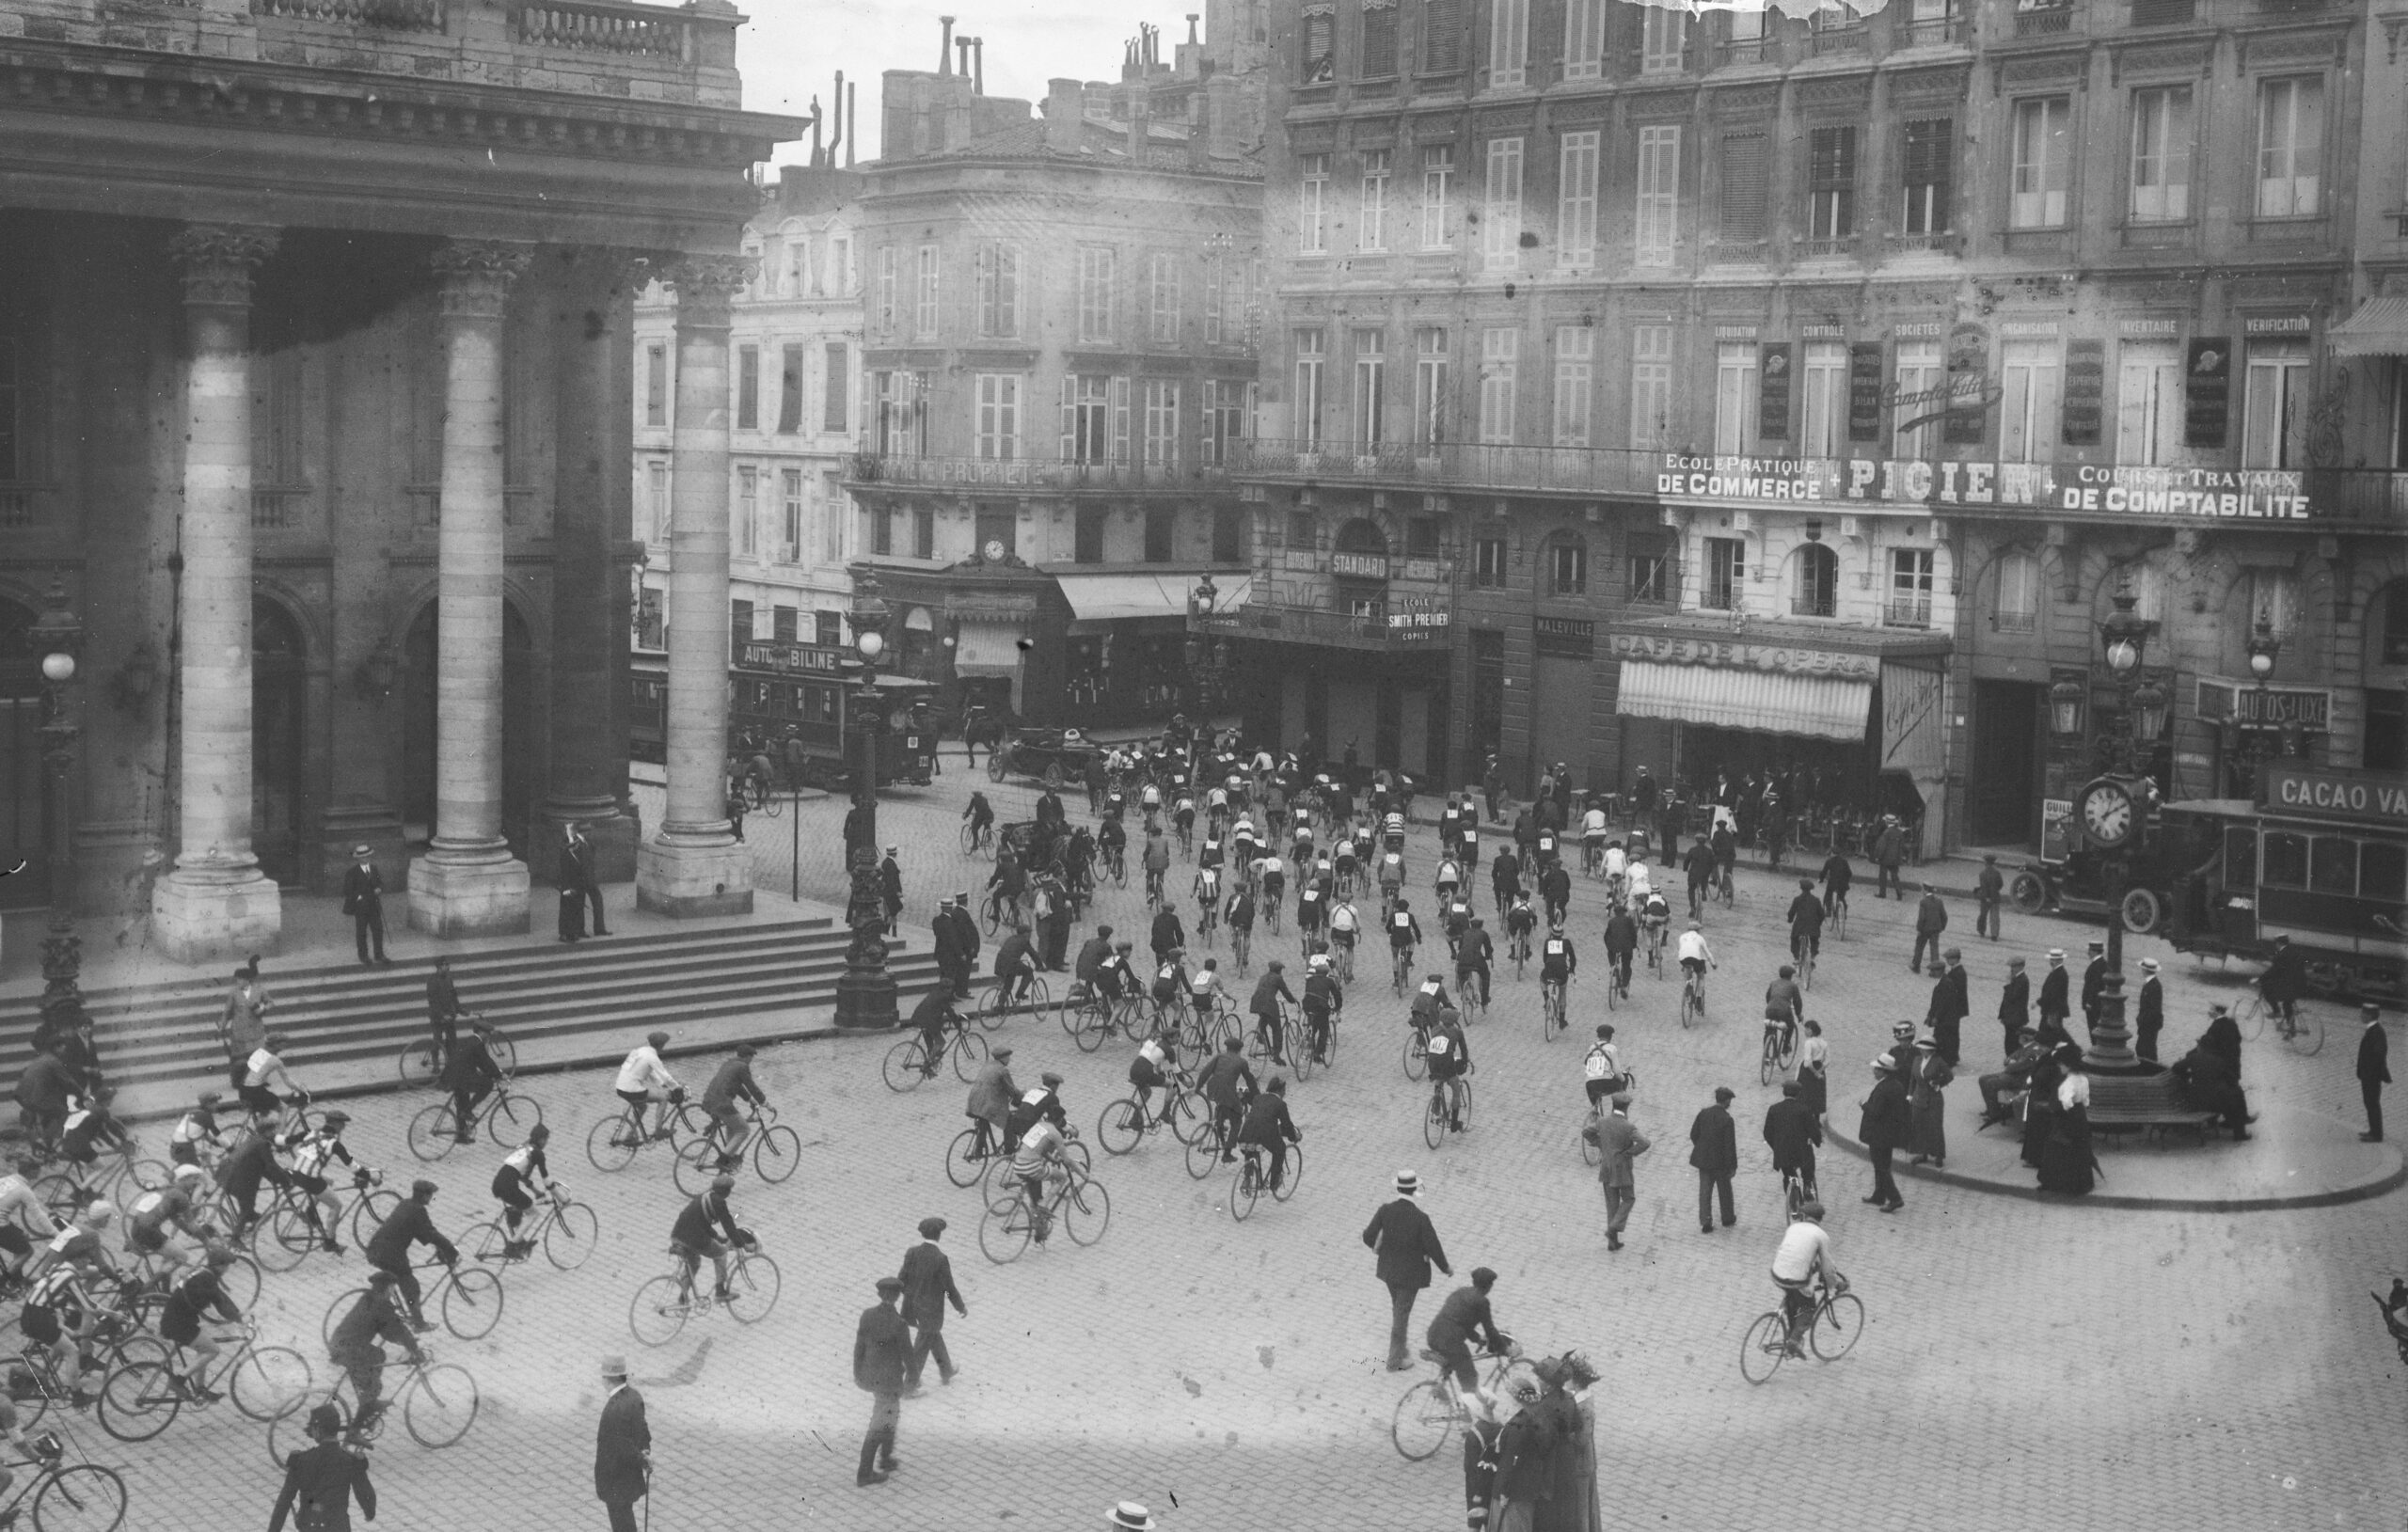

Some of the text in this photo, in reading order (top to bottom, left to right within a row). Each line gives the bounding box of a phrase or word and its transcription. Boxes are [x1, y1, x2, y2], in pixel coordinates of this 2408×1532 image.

[1715, 325, 1756, 339] LIQUIDATION
[2119, 320, 2177, 333] INVENTAIRE
[1727, 456, 1816, 476] PRATIQUE
[1657, 473, 1821, 499] DE COMMERCE
[2079, 466, 2158, 483] COURS
[2190, 469, 2300, 488] TRAVAUX
[2064, 487, 2309, 518] DE COMPTABILITE
[1333, 555, 1386, 576] STANDARD
[1388, 614, 1412, 627] SMITH
[1537, 620, 1592, 637] MALEVILLE
[1697, 640, 1734, 657] DE
[2281, 779, 2368, 811] CACAO
